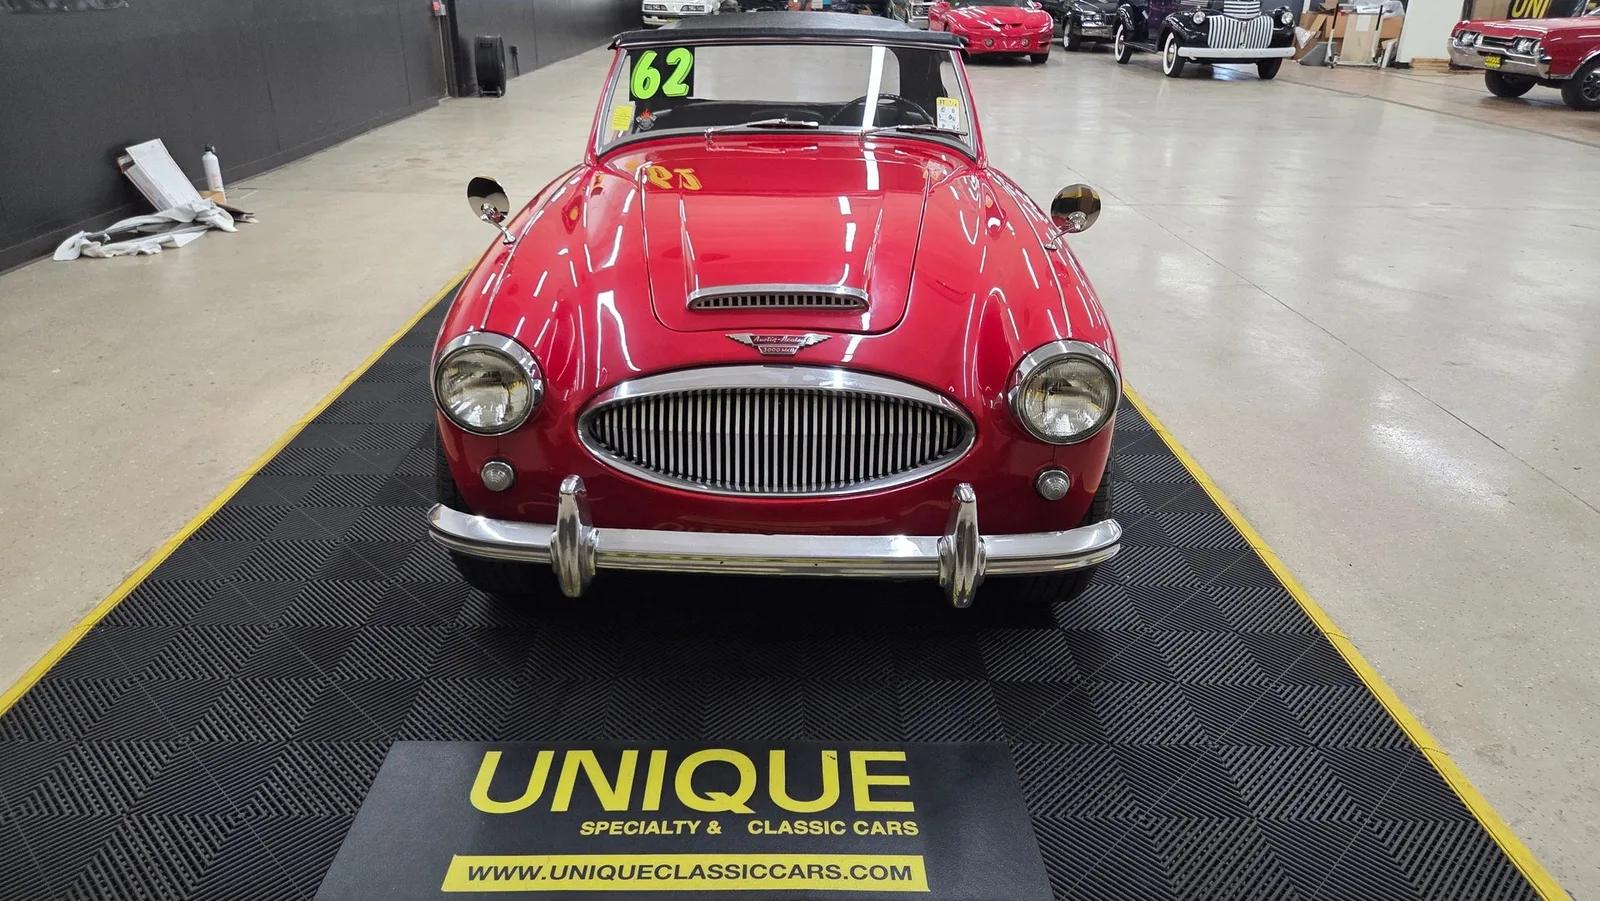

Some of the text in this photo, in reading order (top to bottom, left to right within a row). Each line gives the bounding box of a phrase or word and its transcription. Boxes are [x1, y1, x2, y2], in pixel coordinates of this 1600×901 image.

[630, 48, 693, 99] 62
[471, 749, 914, 814] UNIQUE
[579, 820, 920, 836] SPECIALTY & CLASSIC CARS
[467, 864, 913, 882] WWW.UNIQUECLASSICCARS.COM
